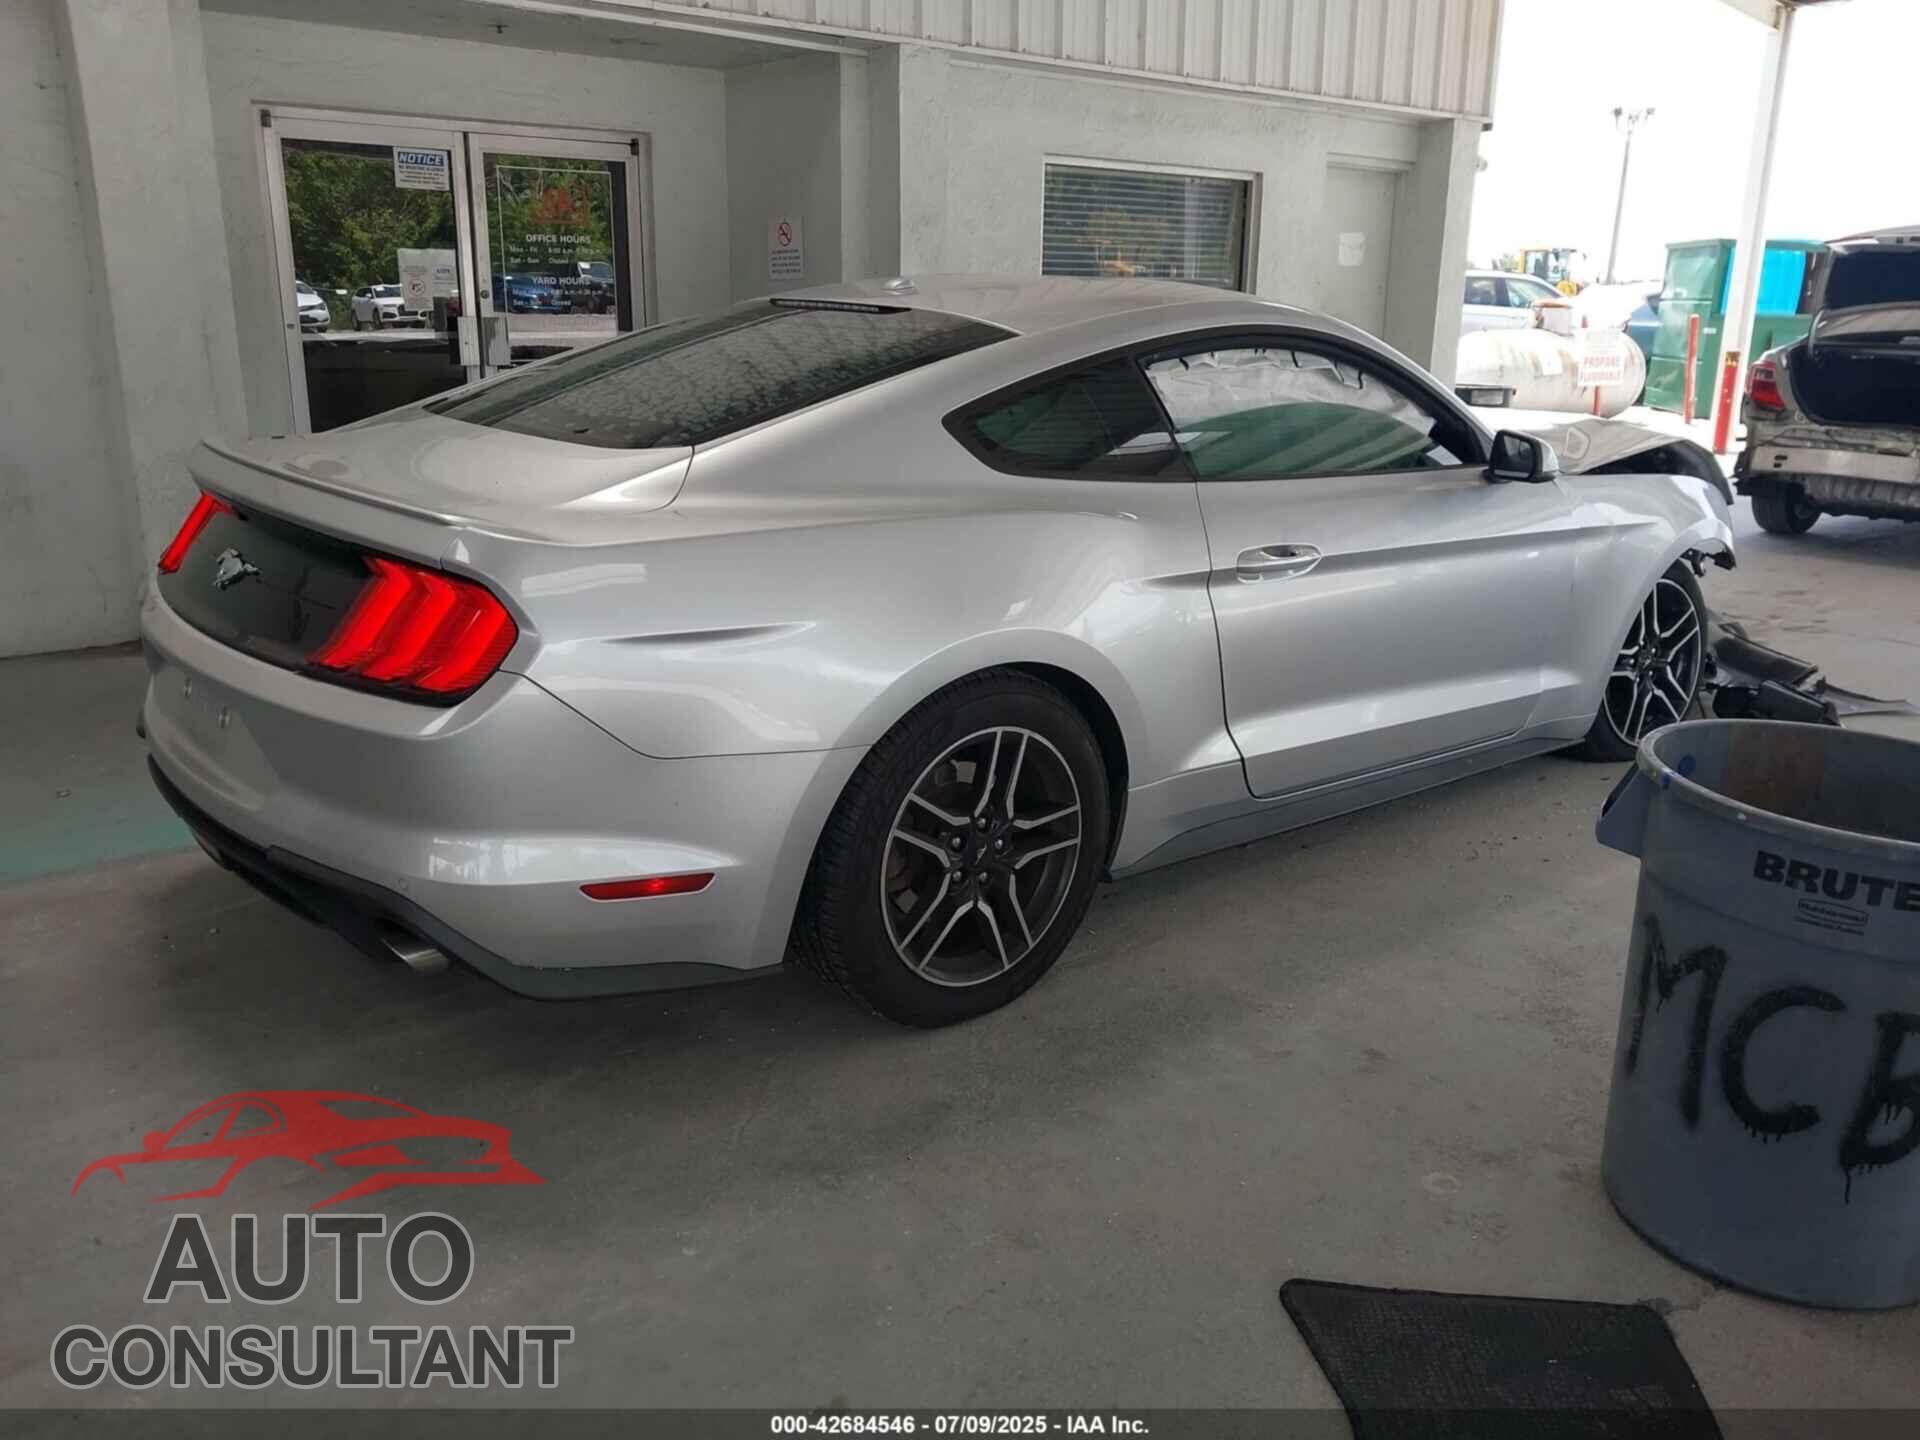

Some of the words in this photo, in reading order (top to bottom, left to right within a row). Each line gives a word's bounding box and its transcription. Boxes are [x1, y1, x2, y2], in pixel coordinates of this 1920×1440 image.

[399, 152, 442, 165] NOTICE
[526, 233, 557, 243] OFFICE
[560, 234, 592, 244] HOURS
[533, 276, 557, 285] YARD
[559, 277, 592, 286] HOURS
[1583, 355, 1621, 368] PROPANE
[1753, 850, 1920, 912] BRUTE
